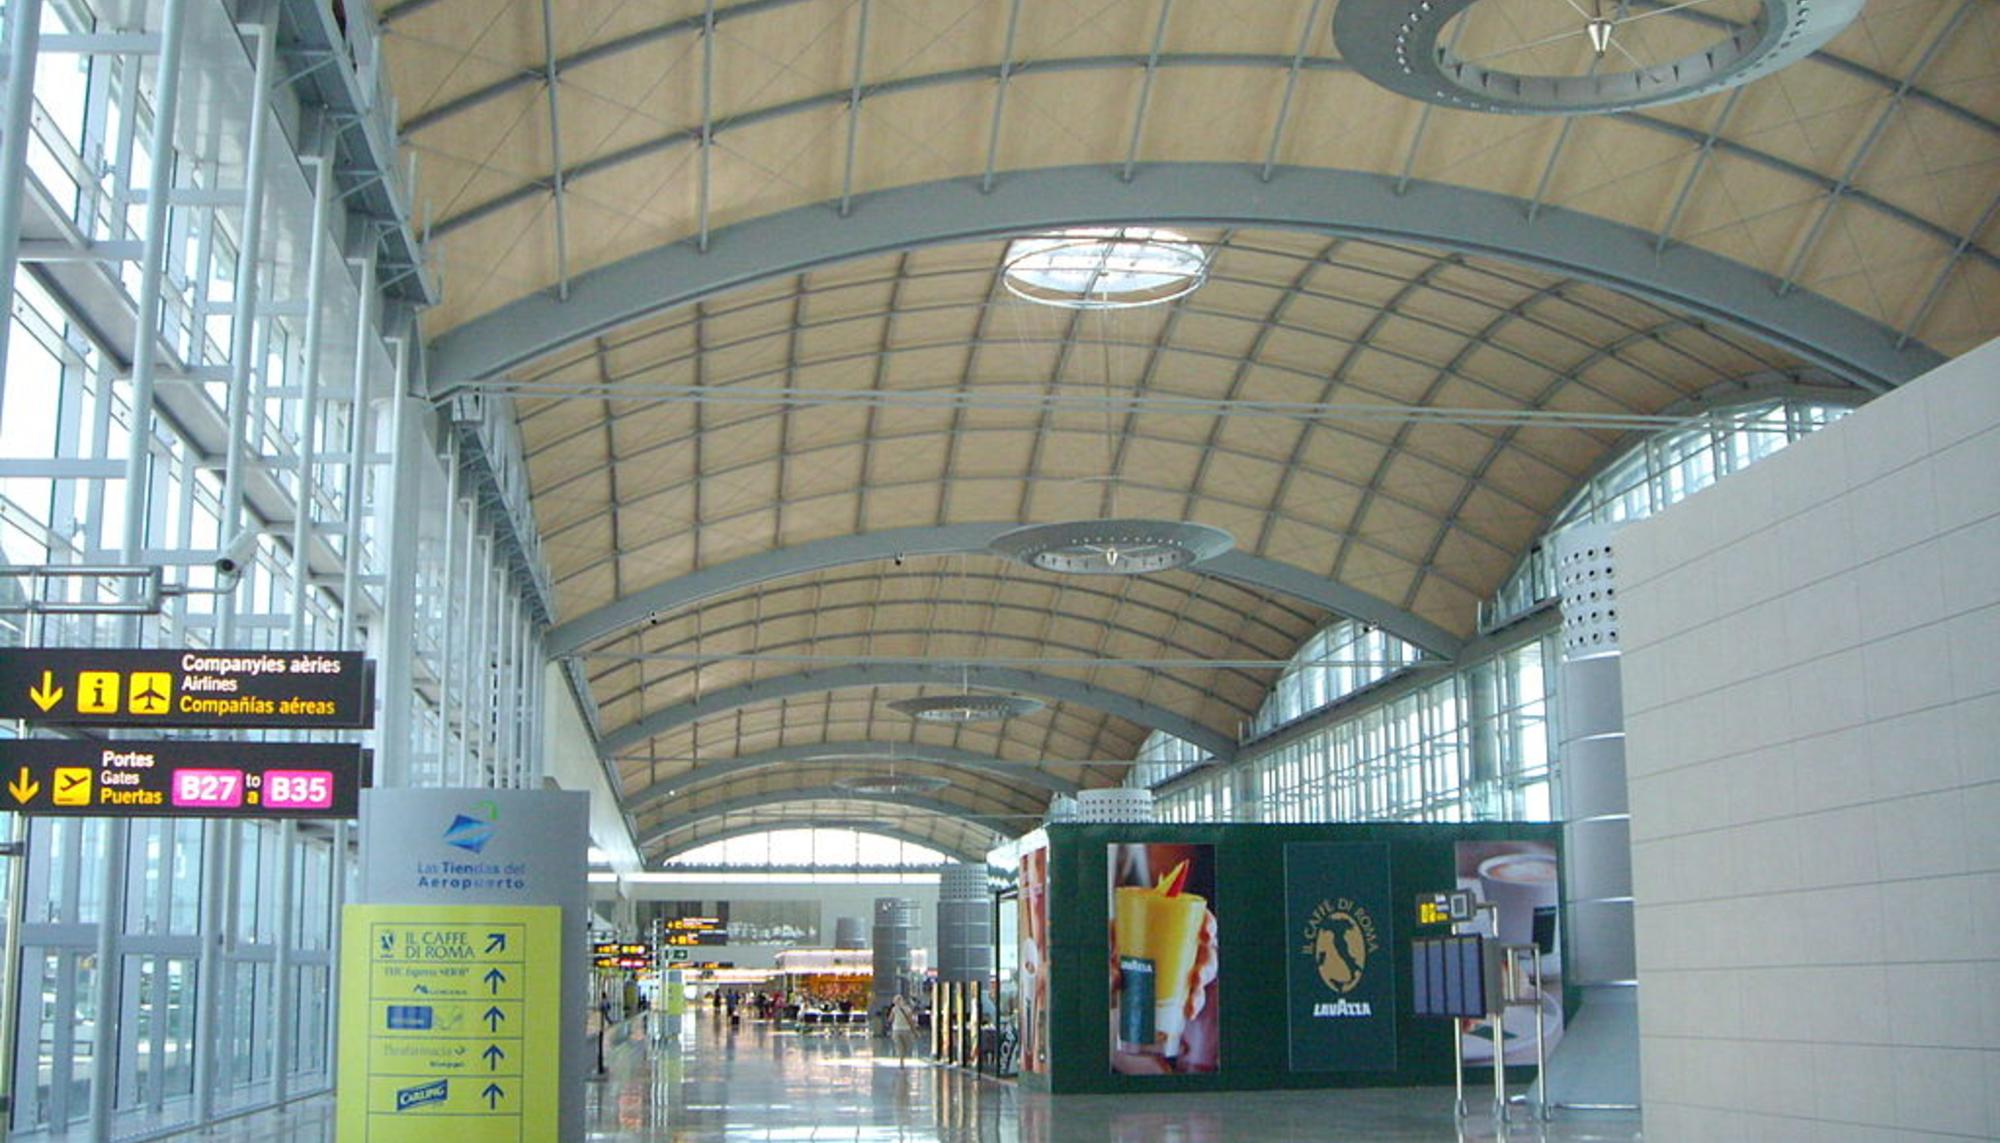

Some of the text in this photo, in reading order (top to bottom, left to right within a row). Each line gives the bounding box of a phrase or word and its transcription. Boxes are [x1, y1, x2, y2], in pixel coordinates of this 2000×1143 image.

[181, 654, 341, 675] Companyies aèries
[181, 675, 238, 692] Airlines
[180, 695, 336, 716] Compañías aéreas
[102, 751, 155, 767] Portes
[101, 770, 140, 786] Gates
[180, 773, 327, 802] B27 to B35
[100, 788, 163, 805] Puertas
[247, 790, 259, 805] a
[405, 945, 476, 959] DI ROMA
[1313, 998, 1372, 1017] LAVAZZA
